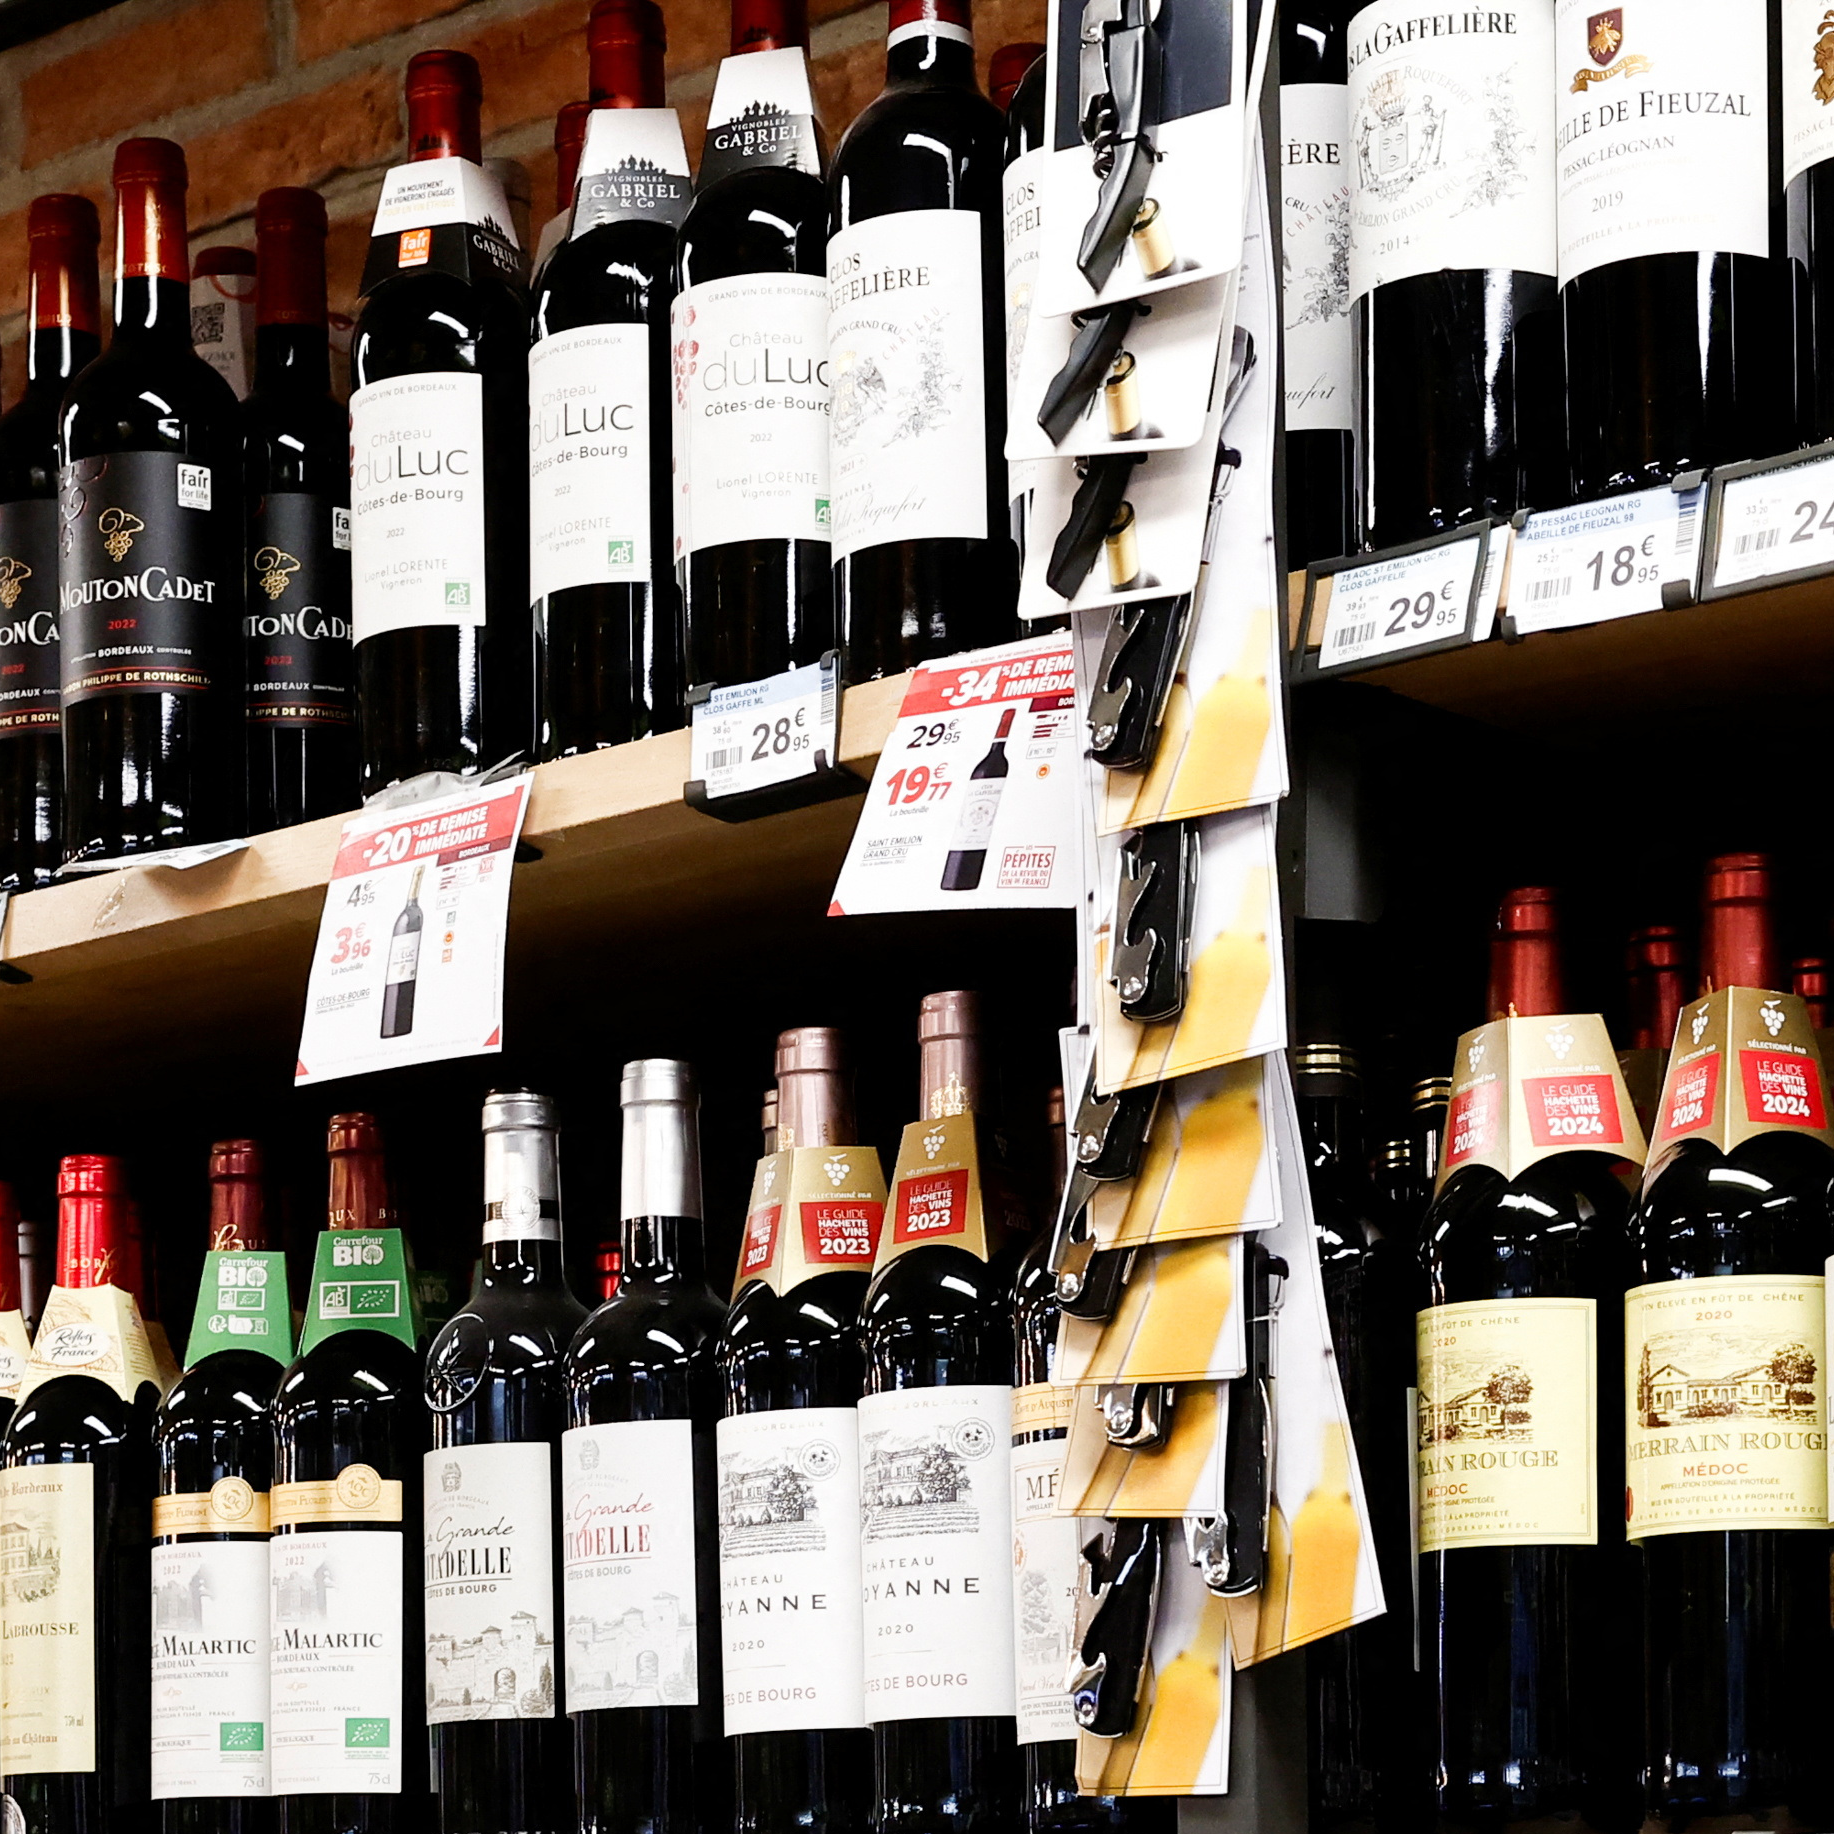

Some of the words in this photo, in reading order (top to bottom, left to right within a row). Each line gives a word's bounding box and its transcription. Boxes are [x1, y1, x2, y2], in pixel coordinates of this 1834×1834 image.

[1598, 98, 1631, 128] DE
[1638, 89, 1752, 119] FIEUZAL
[715, 125, 802, 150] GABRIEL
[591, 183, 680, 199] GABRIEL
[1592, 190, 1624, 213] 2019
[542, 384, 596, 406] Château
[371, 427, 431, 447] Château
[181, 472, 208, 488] fair
[1541, 516, 1577, 530] PESSAC
[1580, 507, 1623, 522] LEOGNAN
[1627, 499, 1642, 509] RG
[1527, 528, 1566, 542] ABEILLE
[1569, 524, 1582, 533] DE
[1584, 517, 1621, 531] FIEUZAL
[98, 645, 153, 657] BORDEAUX
[415, 823, 487, 855] IMMÉDIATE
[867, 837, 888, 848] SAINT
[891, 835, 922, 846] EMILION
[1005, 851, 1050, 868] PÉPITES
[1762, 1094, 1810, 1116] 2024
[1548, 1115, 1604, 1136] 2024
[907, 1211, 951, 1232] 2023
[333, 1246, 384, 1265] BIO
[820, 1238, 870, 1254] 2023
[218, 1266, 267, 1285] BIO
[1460, 1450, 1558, 1470] ROUGE
[1683, 1462, 1749, 1476] MÉDOC
[162, 1635, 257, 1656] MALARTIC
[283, 1629, 384, 1649] MALARTIC
[884, 1678, 903, 1691] DE
[907, 1673, 968, 1689] BOURG
[736, 1691, 753, 1703] DE
[758, 1687, 817, 1703] BOURG
